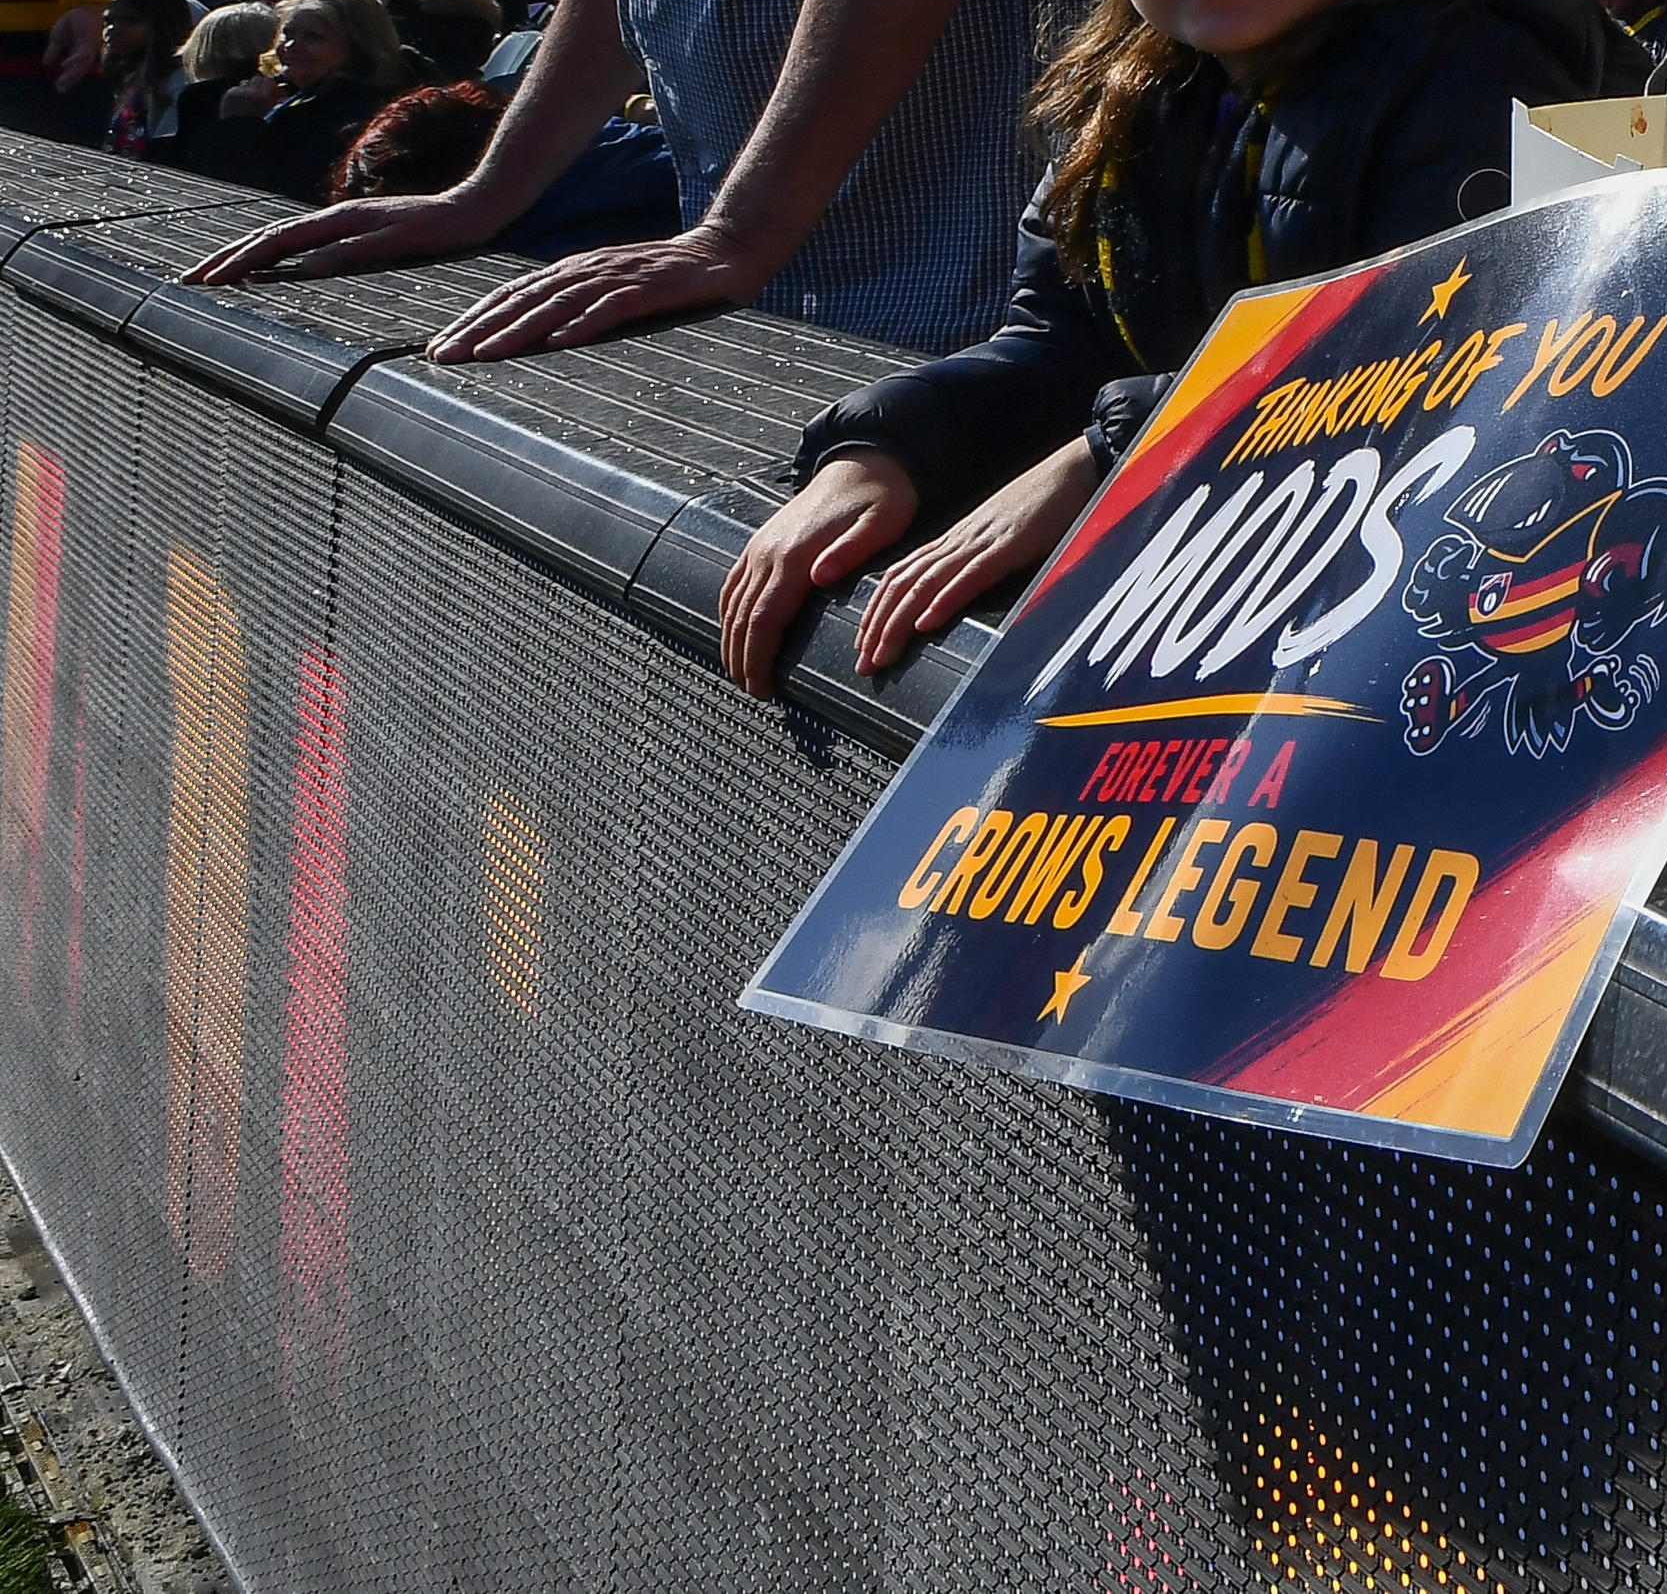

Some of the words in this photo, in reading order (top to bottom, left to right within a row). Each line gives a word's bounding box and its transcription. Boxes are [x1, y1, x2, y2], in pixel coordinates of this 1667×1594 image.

[1220, 341, 1432, 470] THINKING
[1422, 326, 1528, 412] OF
[1023, 425, 1477, 704] MODS
[1078, 736, 1248, 805] FOREVER
[1247, 741, 1294, 810] A
[897, 806, 1131, 931] CROWS
[1106, 815, 1482, 983] LEGEND
